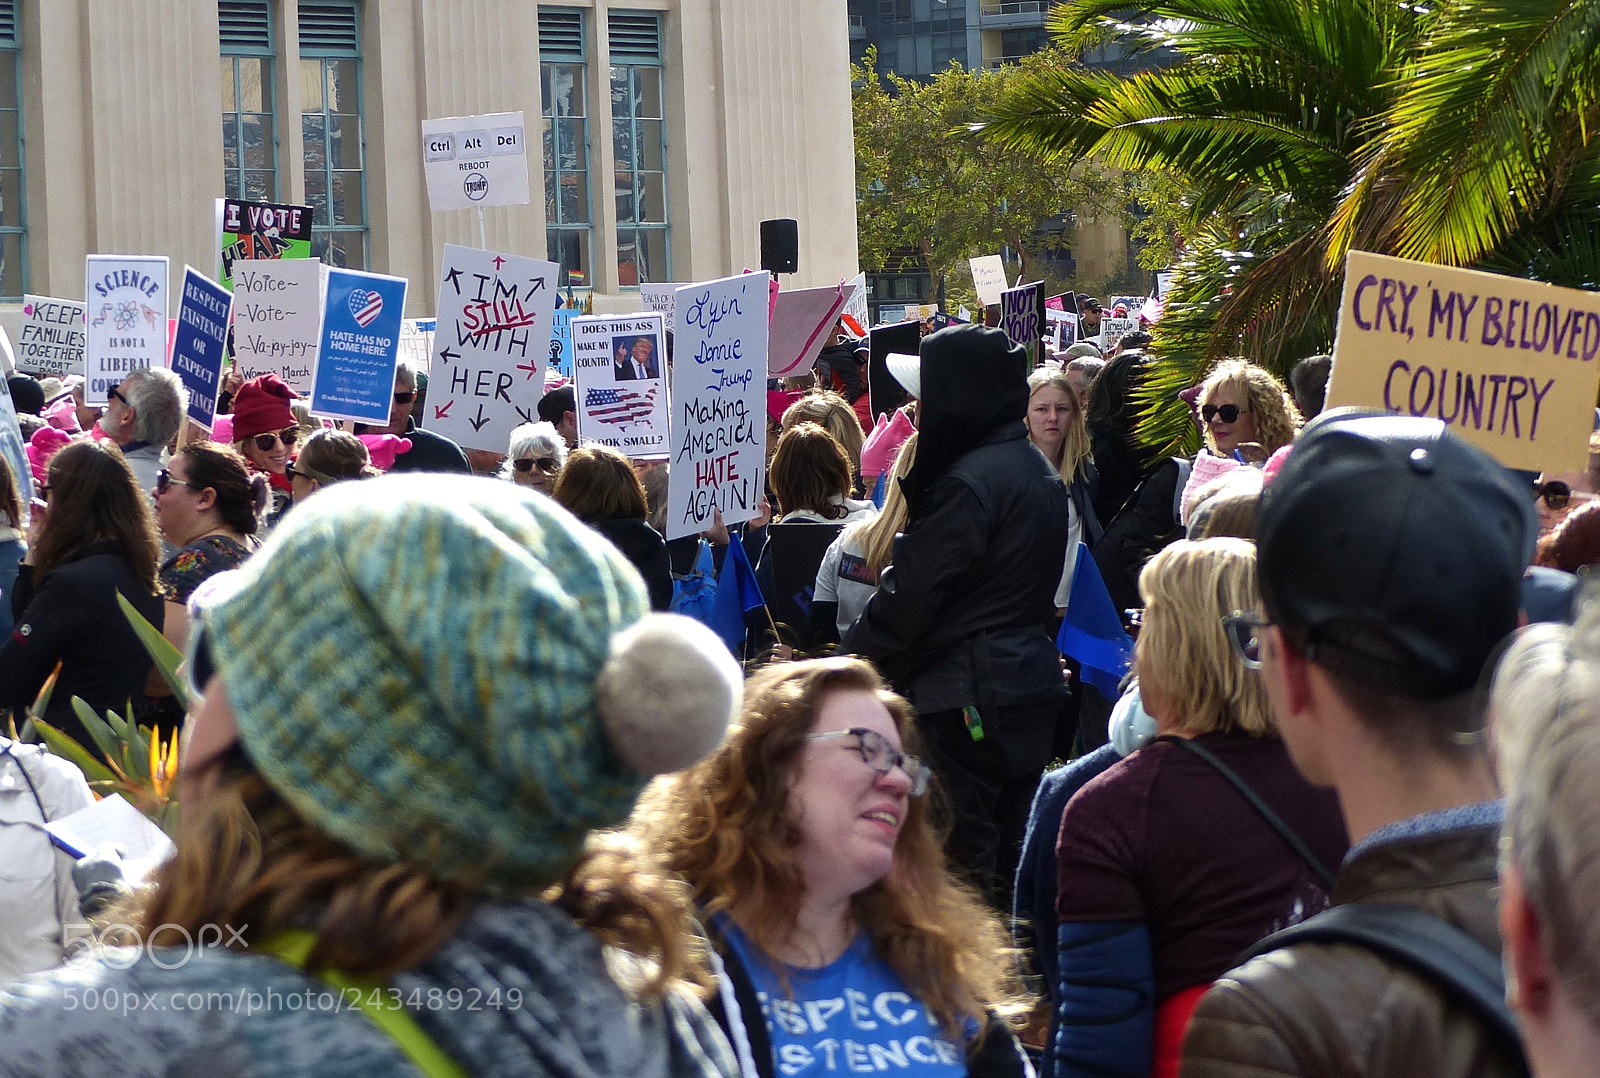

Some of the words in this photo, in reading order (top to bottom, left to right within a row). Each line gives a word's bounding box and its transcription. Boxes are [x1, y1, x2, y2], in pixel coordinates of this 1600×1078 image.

[430, 140, 450, 152] Ctrl
[464, 138, 482, 149] Alt
[497, 134, 516, 146] Del
[459, 161, 489, 171] REBOOT
[466, 180, 487, 193] TRUMP
[225, 204, 241, 231] I
[248, 206, 302, 234] VOTE
[95, 269, 159, 298] SCIENCE
[471, 273, 518, 312] I'M
[185, 281, 228, 318] RESPECT
[686, 284, 746, 338] Lyin'
[1007, 287, 1036, 316] NOT
[33, 302, 83, 326] KEEP
[181, 304, 224, 343] EXISTENCE
[463, 298, 536, 331] STILL
[1353, 273, 1418, 343] CRY,
[1481, 296, 1600, 362] BELOVED
[22, 324, 86, 348] FAMILIES
[330, 330, 354, 343] HATE
[355, 334, 374, 345] HAS
[376, 337, 391, 348] NO
[456, 318, 529, 358] WITH
[582, 325, 607, 334] DOES
[611, 324, 631, 332] THIS
[635, 321, 653, 331] ASS
[1006, 313, 1038, 343] YOUR
[19, 342, 84, 362] TOGETHER
[109, 337, 118, 348] IS
[121, 337, 137, 348] NOT
[140, 337, 146, 348] A
[193, 337, 207, 355] OR
[330, 340, 359, 353] HOME
[361, 345, 388, 357] HERE.
[577, 341, 597, 351] MAKE
[598, 341, 609, 350] MY
[23, 357, 73, 370] SUPPORT
[178, 353, 214, 384] EXPECT
[282, 364, 310, 379] March
[577, 356, 610, 368] COUNTRY
[450, 365, 512, 404] HER
[705, 368, 753, 392] Trump
[1383, 359, 1555, 441] COUNTRY
[600, 439, 621, 447] OOK
[623, 435, 663, 447] SMALL?
[676, 420, 759, 464] AMERICA
[695, 450, 740, 491] HATE
[780, 1035, 958, 1076] STENCE
